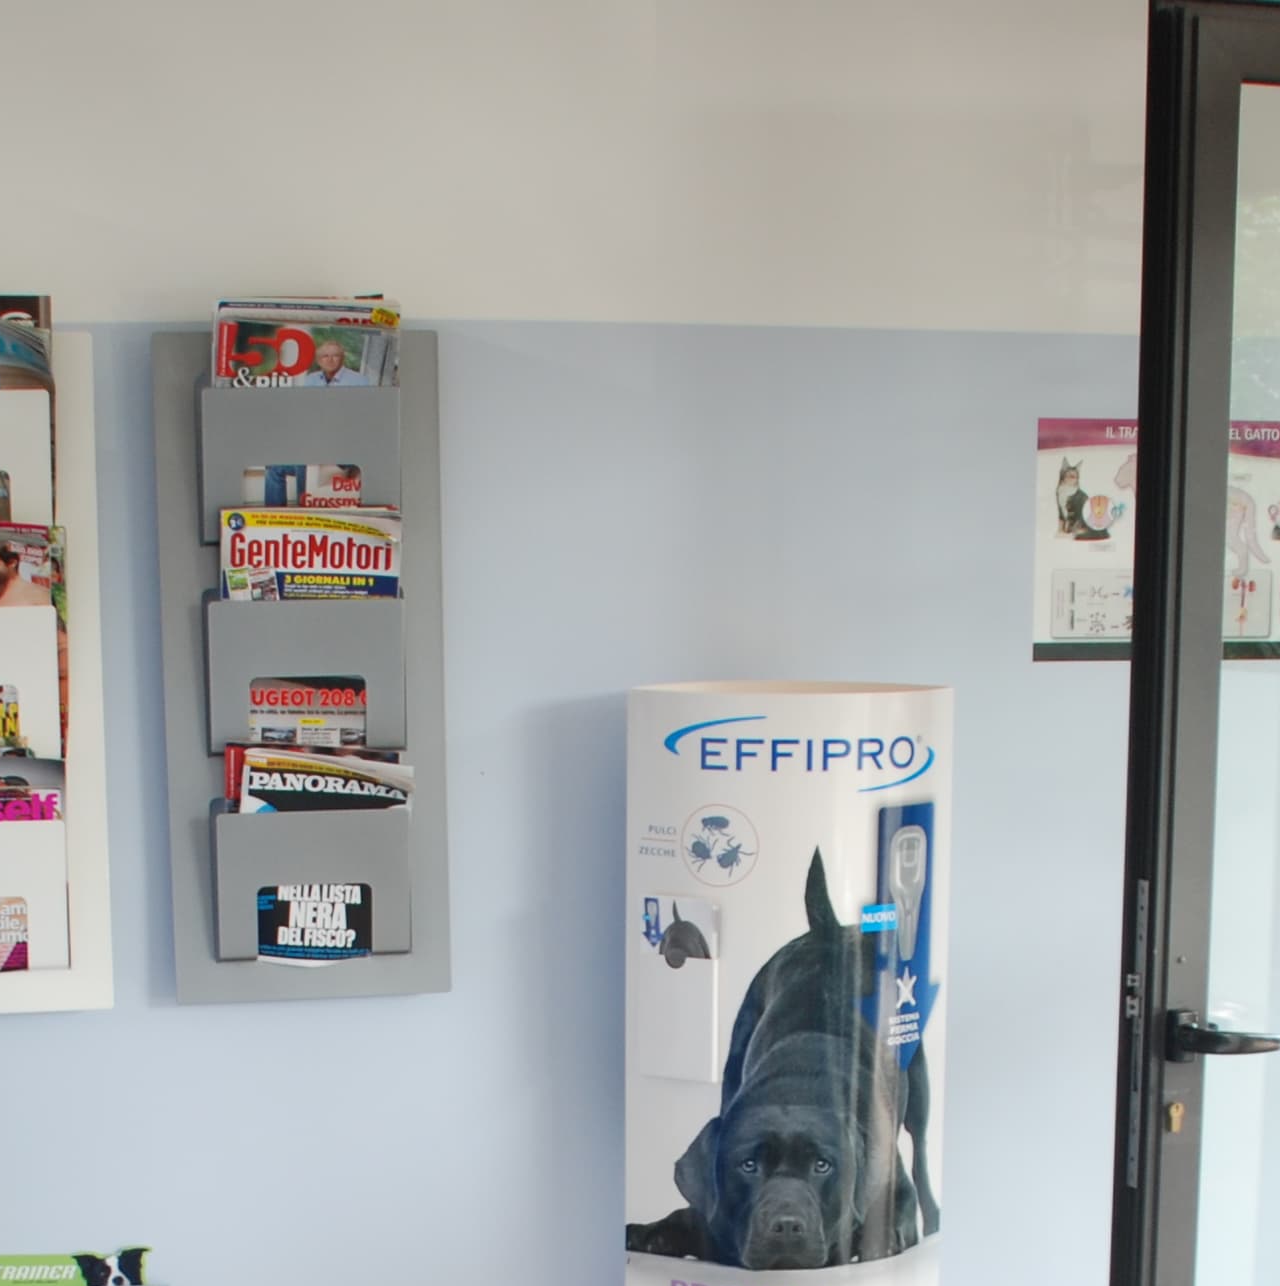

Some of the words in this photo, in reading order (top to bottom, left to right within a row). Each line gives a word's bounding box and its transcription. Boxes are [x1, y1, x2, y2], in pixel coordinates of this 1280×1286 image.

[1106, 426, 1116, 439] IL
[1244, 428, 1280, 441] GATTO
[230, 532, 392, 571] GenteMotori
[250, 688, 313, 707] UGEOT
[320, 688, 355, 707] 208
[700, 736, 915, 771] EFFIPRO
[249, 771, 409, 801] PANORAMA
[277, 884, 320, 902] NELLA
[322, 884, 362, 904] LISTA
[289, 900, 348, 930] NERA
[862, 910, 896, 923] NUOVO
[277, 926, 302, 946] DEL
[304, 928, 356, 948] FISCO?
